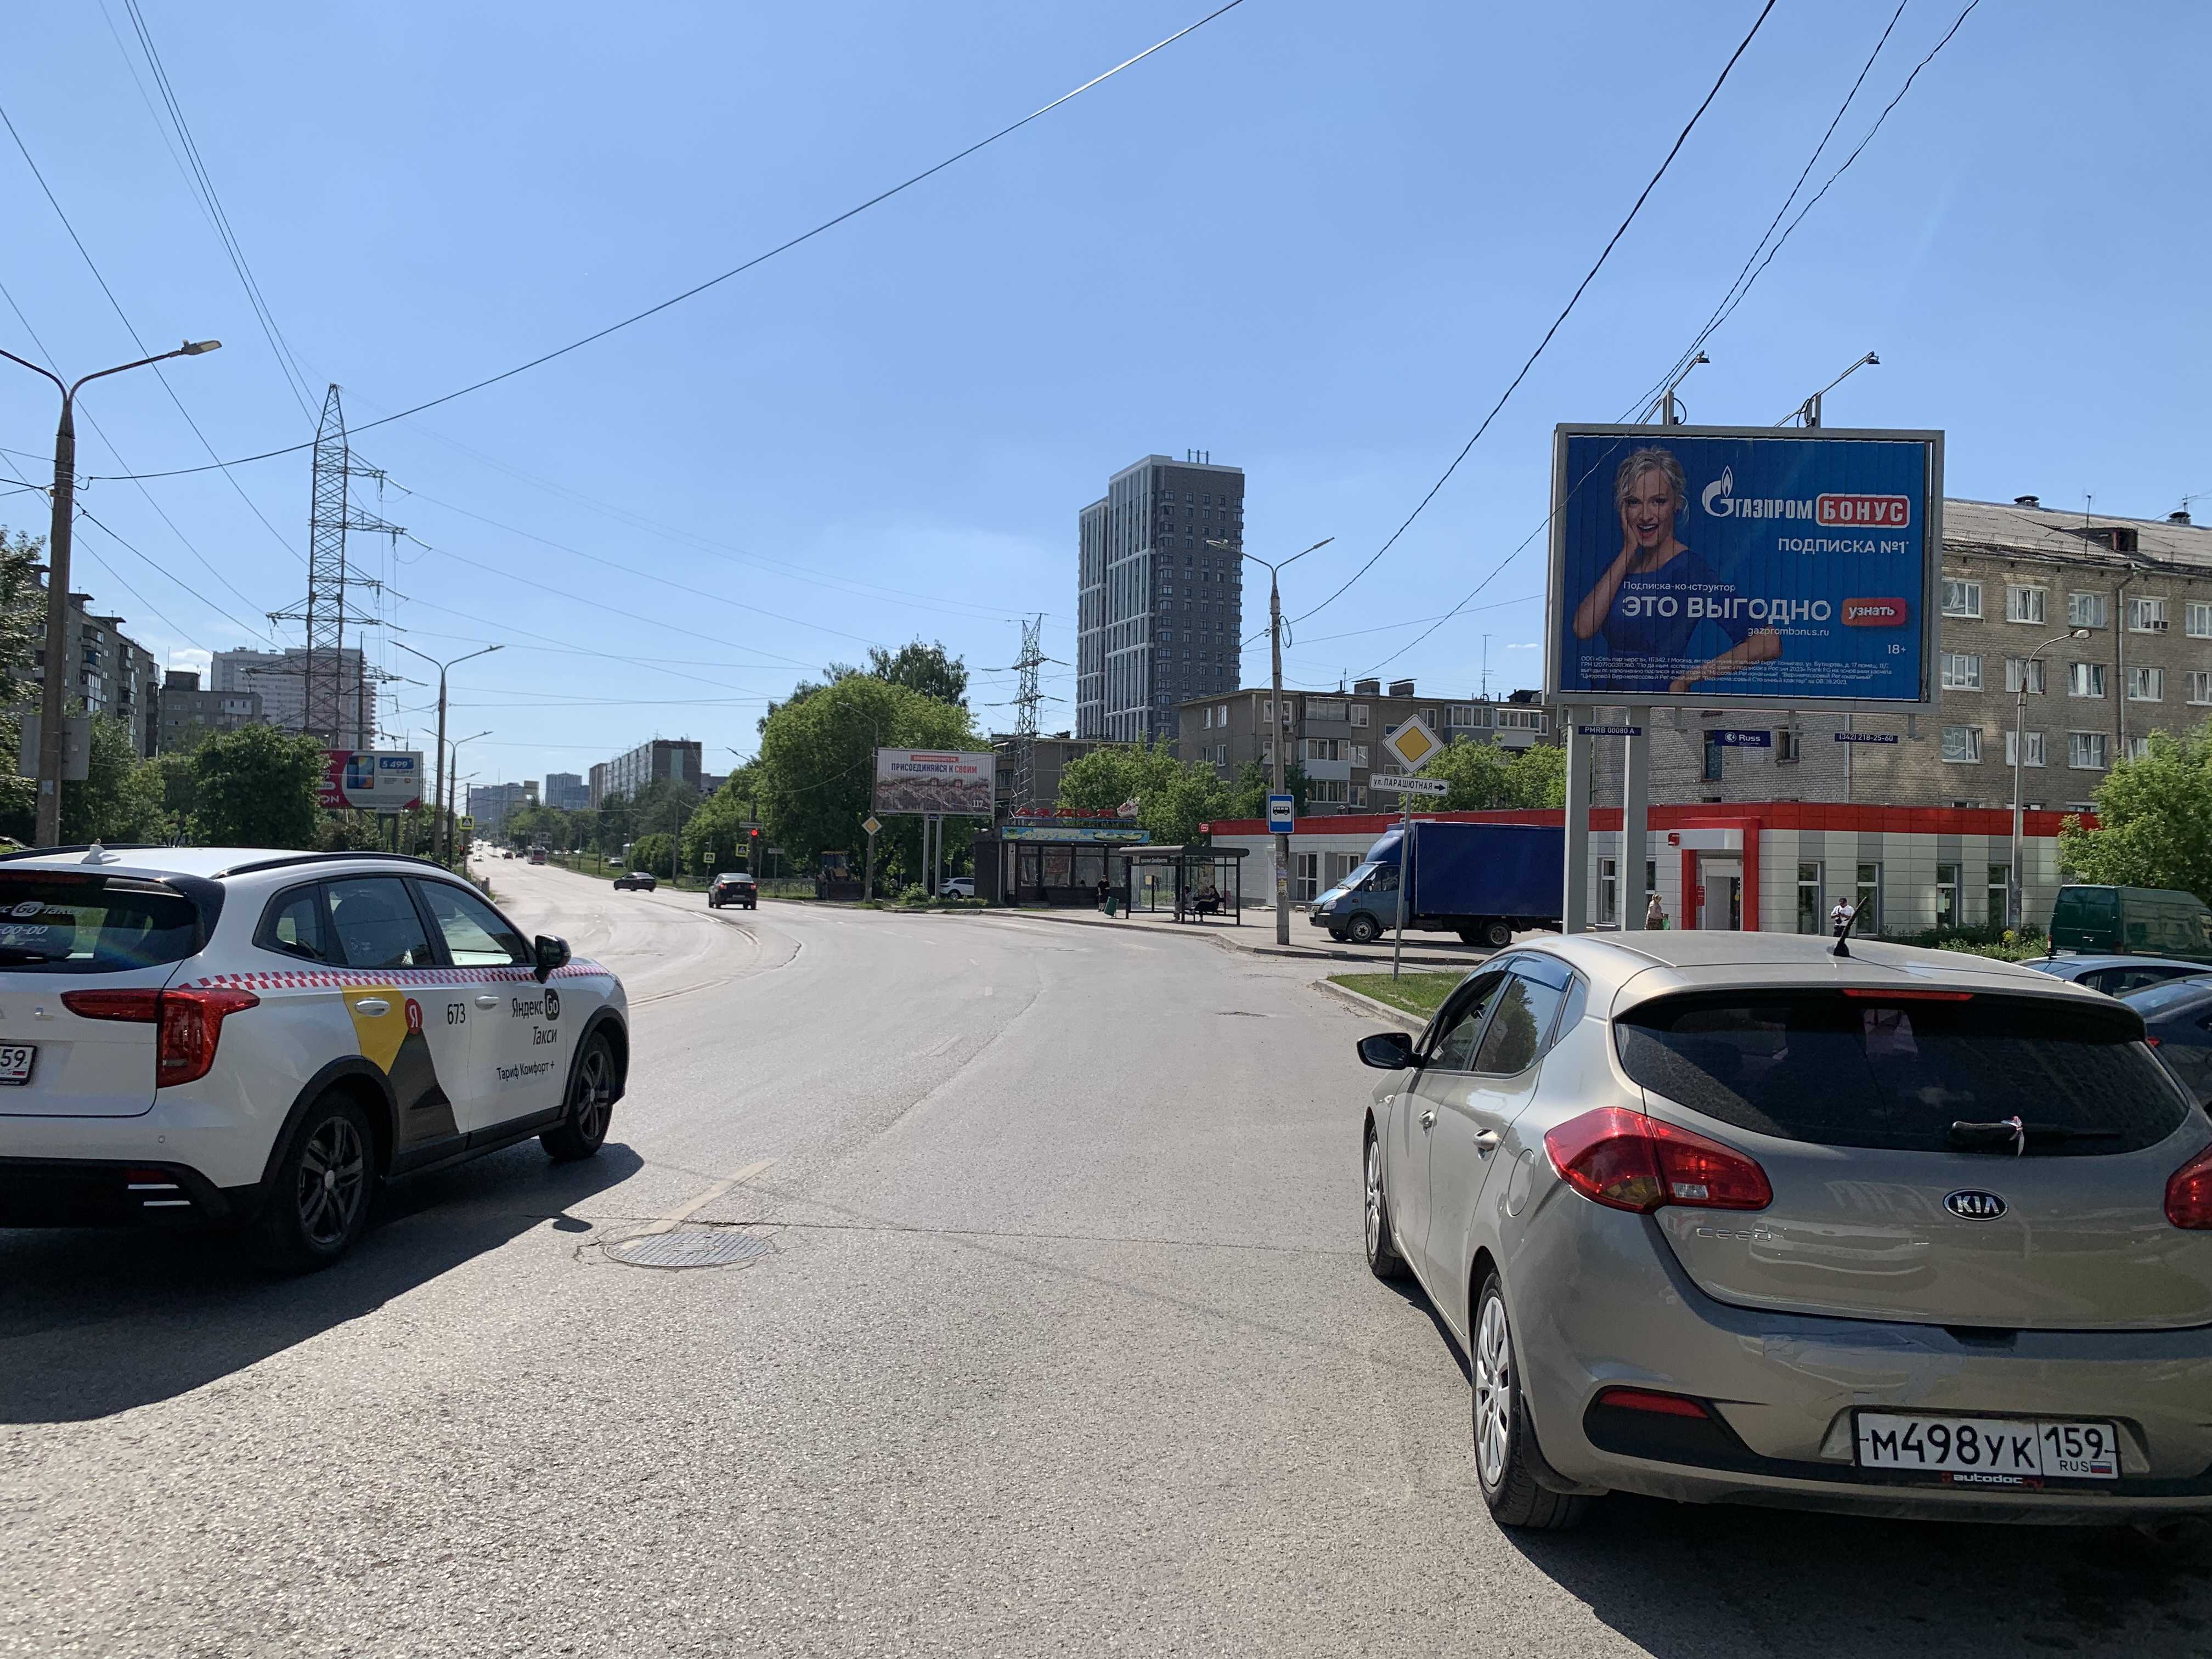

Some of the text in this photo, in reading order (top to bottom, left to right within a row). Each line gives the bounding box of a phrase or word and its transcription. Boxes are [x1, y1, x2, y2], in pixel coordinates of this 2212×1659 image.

[1735, 498, 1904, 522] ГАЗПРОМ БОНУС
[1778, 537, 1876, 555] ПОДПИСКА
[1621, 596, 1831, 625] ЭТО ВЫГОДНО
[1848, 606, 1895, 619] узнать
[1887, 644, 1906, 654] 18+
[891, 763, 978, 774] ПРИСОЕДИНЯЙСЯ К СВОИМ
[1374, 778, 1433, 790] ул. ПАРАШЮТНАЯ
[447, 1002, 466, 1025] 673
[512, 994, 559, 1019] Яндекс Go
[411, 1005, 417, 1028] Я
[532, 1026, 557, 1045] Такси
[0, 1048, 26, 1068] 59
[496, 1064, 520, 1082] Тариф
[521, 1060, 550, 1077] Комфорт
[1955, 1195, 2000, 1214] KIA
[2044, 1426, 2105, 1459] 159
[2059, 1459, 2089, 1472] RUS
[1953, 1473, 2024, 1484] autodoc
